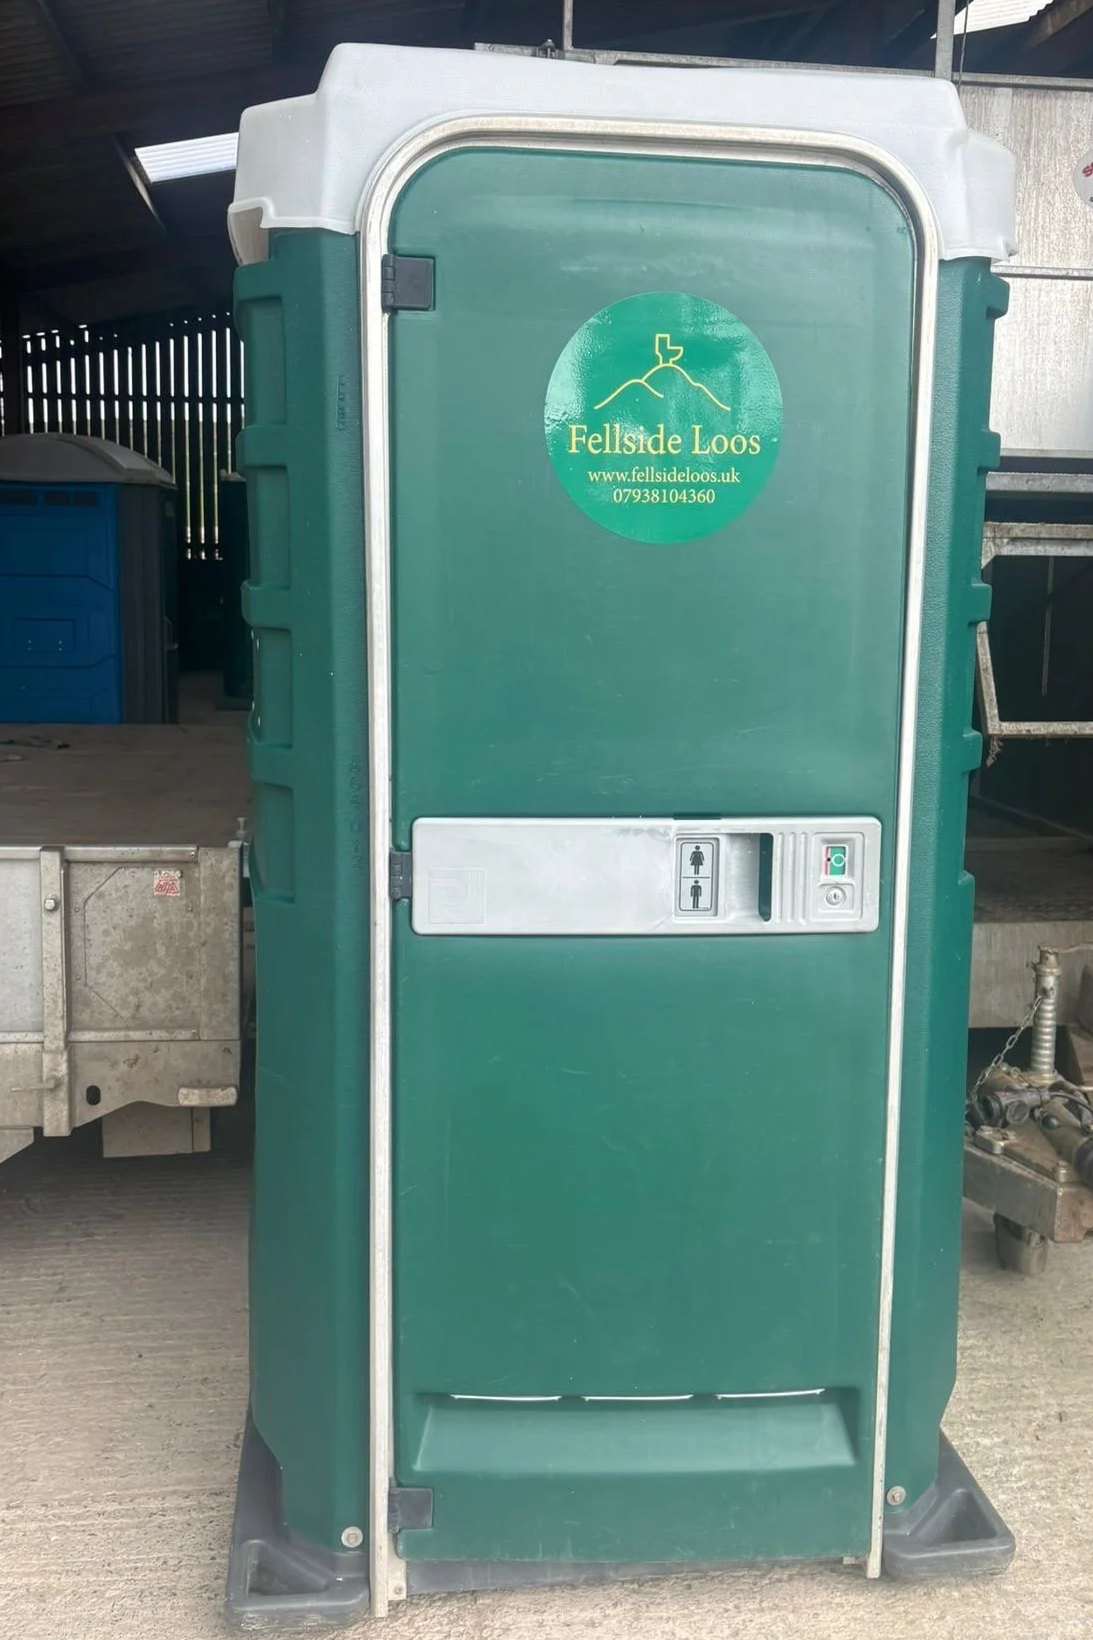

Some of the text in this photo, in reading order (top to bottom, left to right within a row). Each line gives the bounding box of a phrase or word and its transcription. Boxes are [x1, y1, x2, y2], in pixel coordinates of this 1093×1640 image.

[568, 423, 761, 455] Fellside Loos
[588, 466, 740, 483] www.fellsideloos.uk
[613, 488, 716, 503] 07938104360
